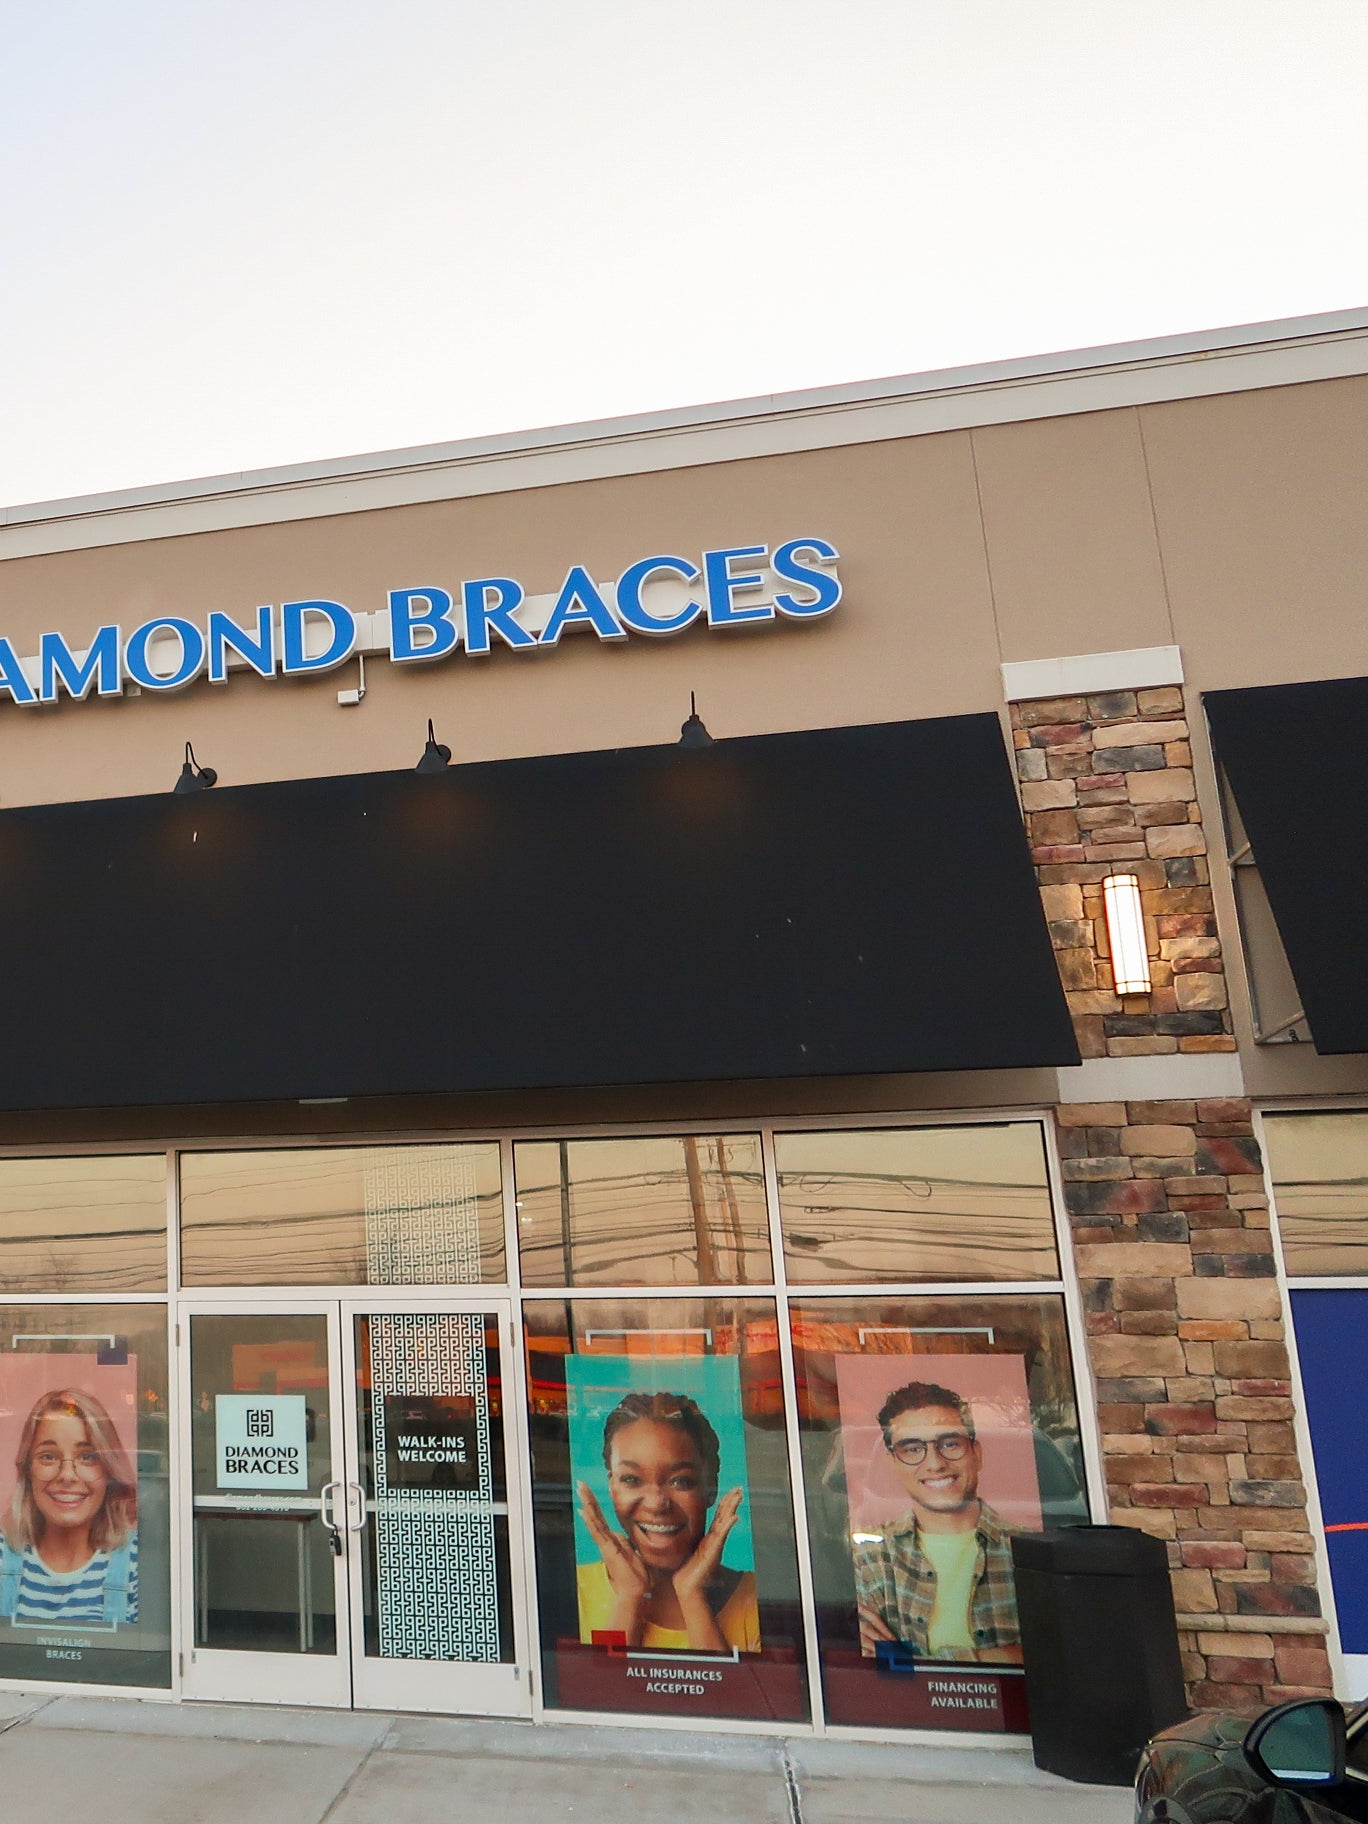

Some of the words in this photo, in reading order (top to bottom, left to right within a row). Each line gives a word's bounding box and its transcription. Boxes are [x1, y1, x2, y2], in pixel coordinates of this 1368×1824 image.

[387, 537, 844, 663] BRACES
[397, 1435, 465, 1448] WALK-INS
[225, 1446, 299, 1458] DIAMOND
[397, 1450, 466, 1463] WELCOME
[225, 1459, 299, 1474] BRACES
[36, 1636, 91, 1648] INVISALIGN
[45, 1649, 83, 1660] BRACES
[626, 1667, 647, 1677] ALL
[650, 1668, 723, 1681] INSURANCES
[646, 1682, 705, 1695] ACCEPTED
[927, 1681, 998, 1694] FINANCING
[930, 1697, 998, 1709] AVAILABLE
